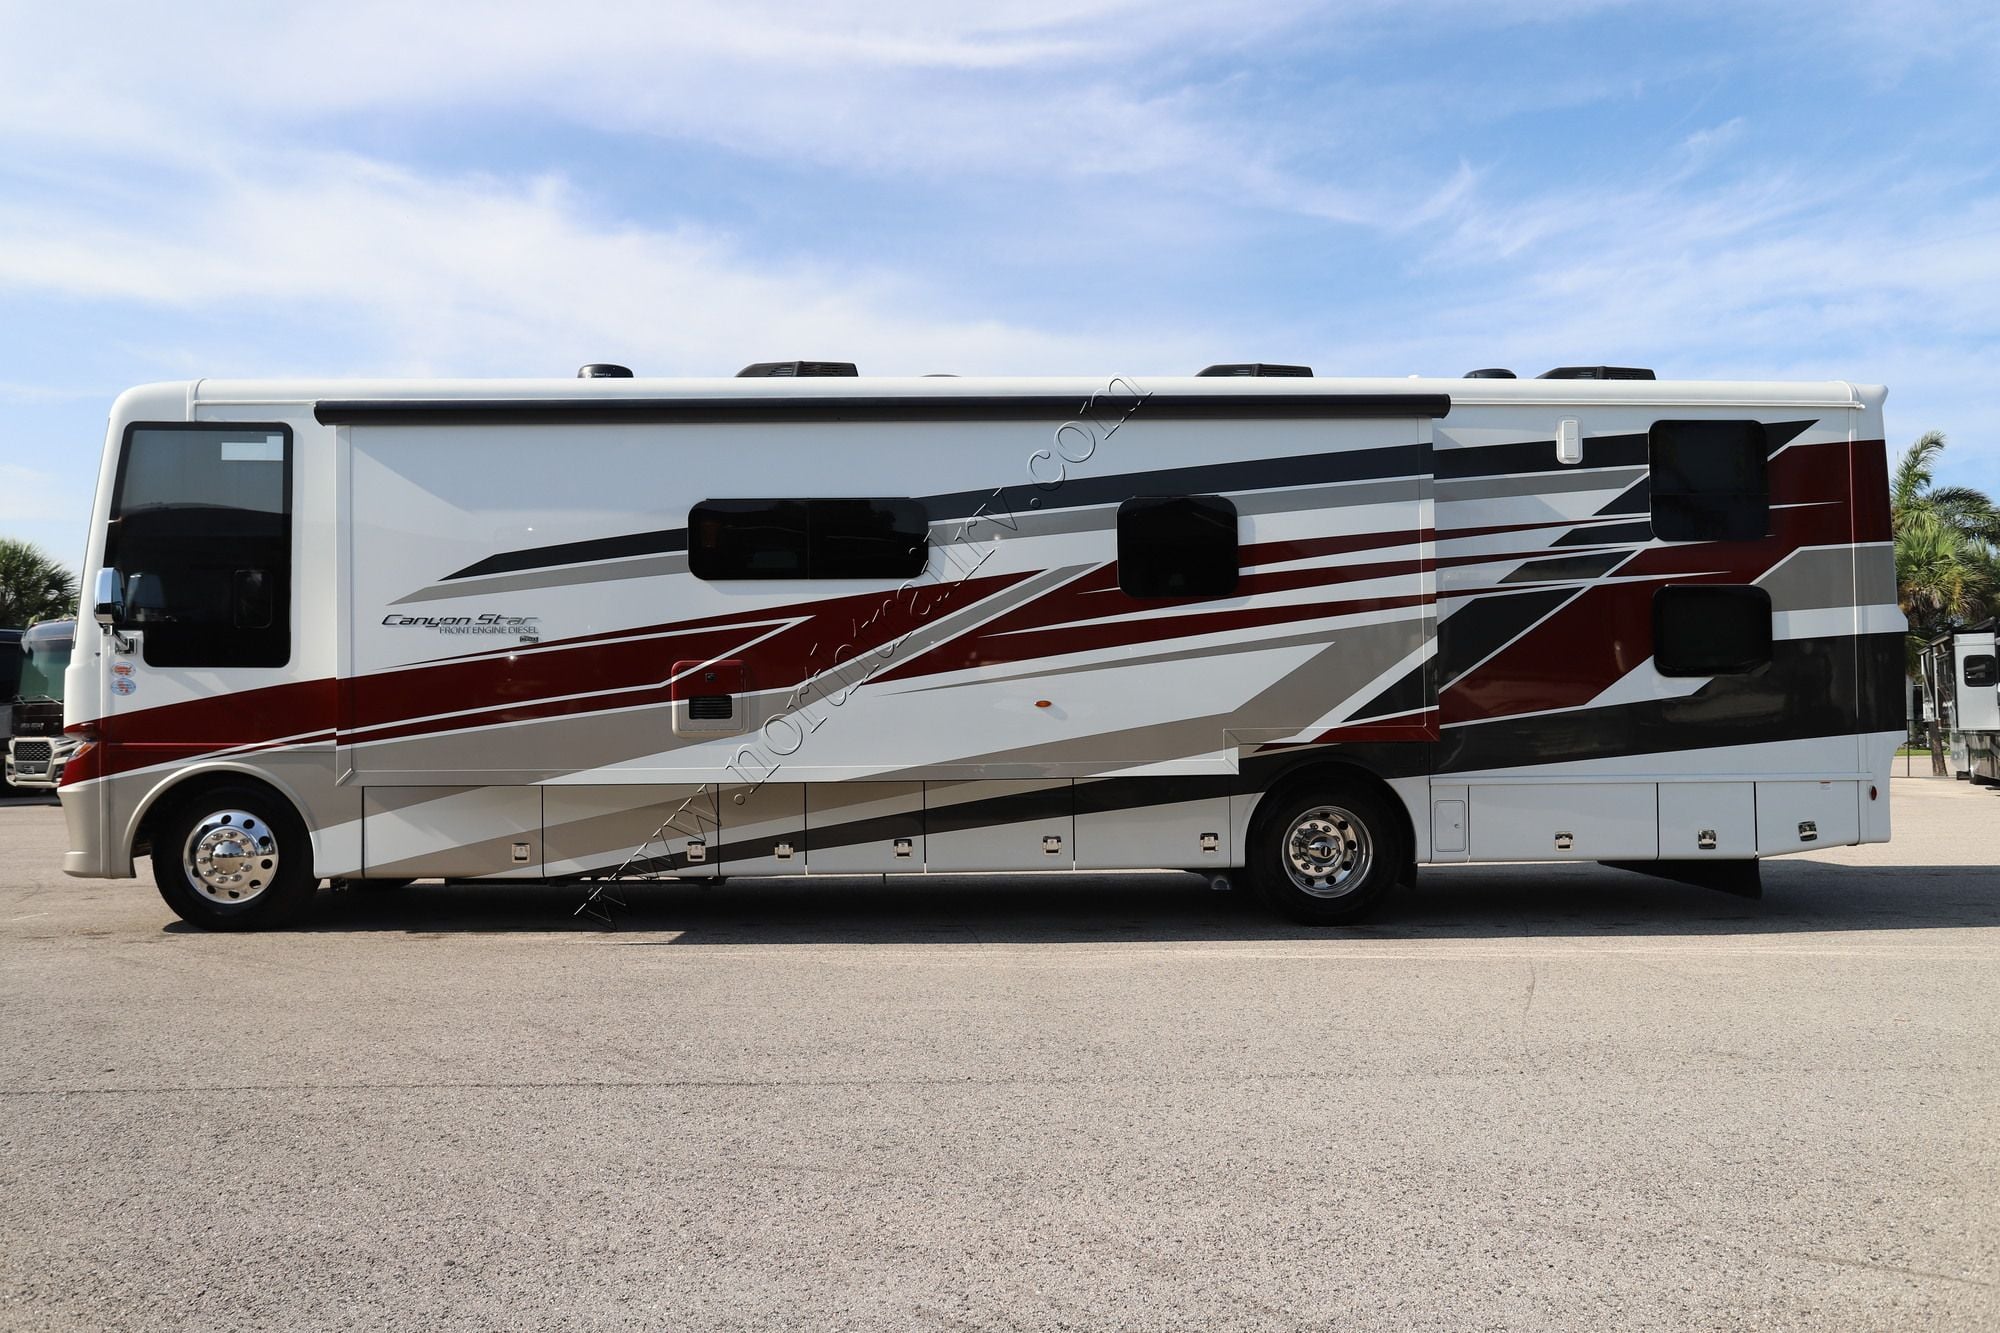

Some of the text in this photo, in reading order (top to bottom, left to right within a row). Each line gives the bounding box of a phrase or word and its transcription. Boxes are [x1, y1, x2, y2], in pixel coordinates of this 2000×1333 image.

[381, 614, 539, 628] Canyon Star
[440, 626, 538, 634] FRONT ENGINE DIESEL
